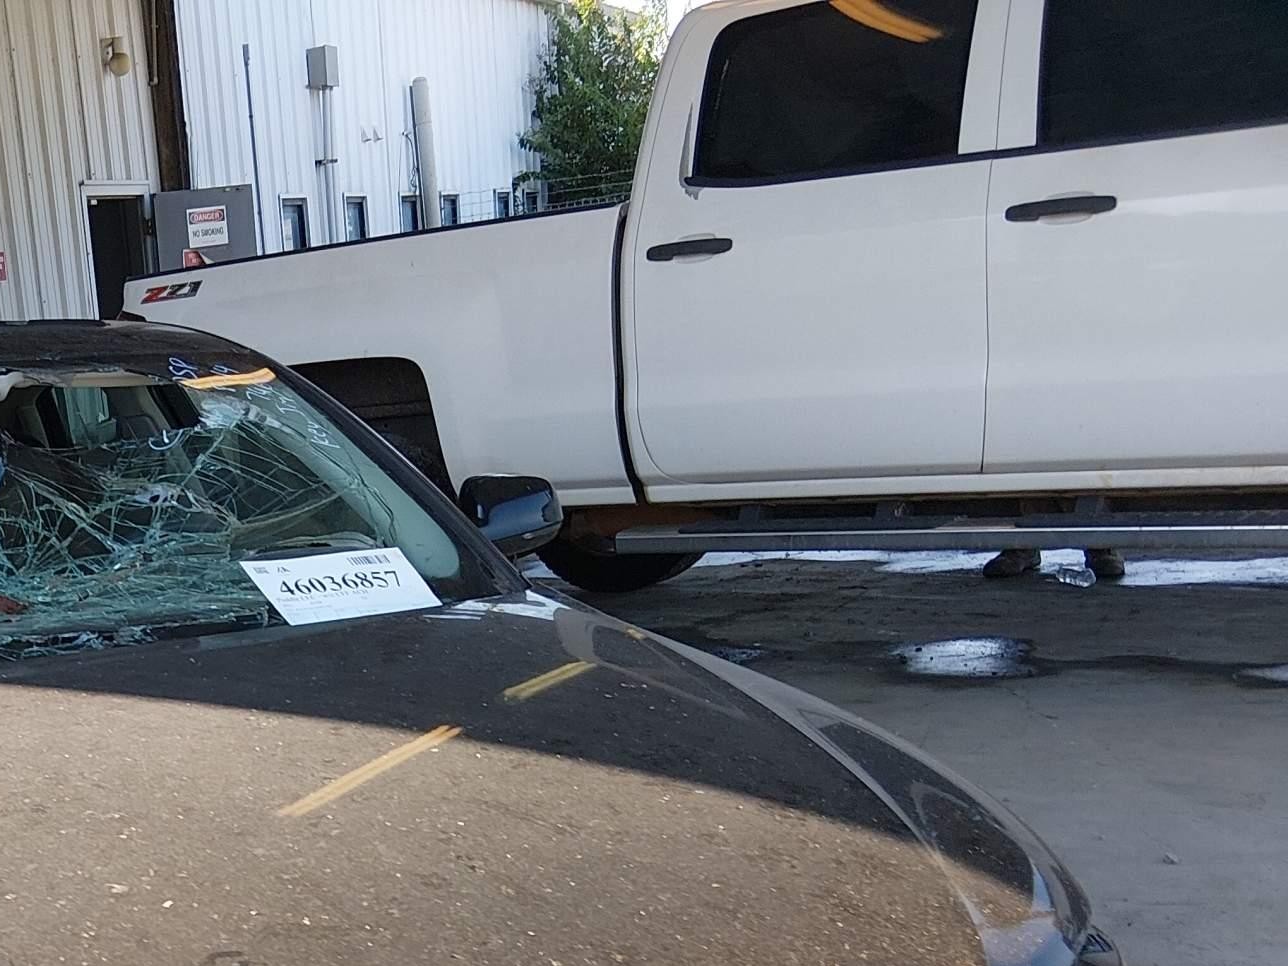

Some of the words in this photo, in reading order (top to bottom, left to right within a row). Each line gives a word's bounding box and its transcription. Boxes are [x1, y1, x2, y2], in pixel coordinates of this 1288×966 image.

[193, 212, 220, 221] DANGER
[192, 230, 200, 238] NO
[280, 570, 401, 596] 46036857
